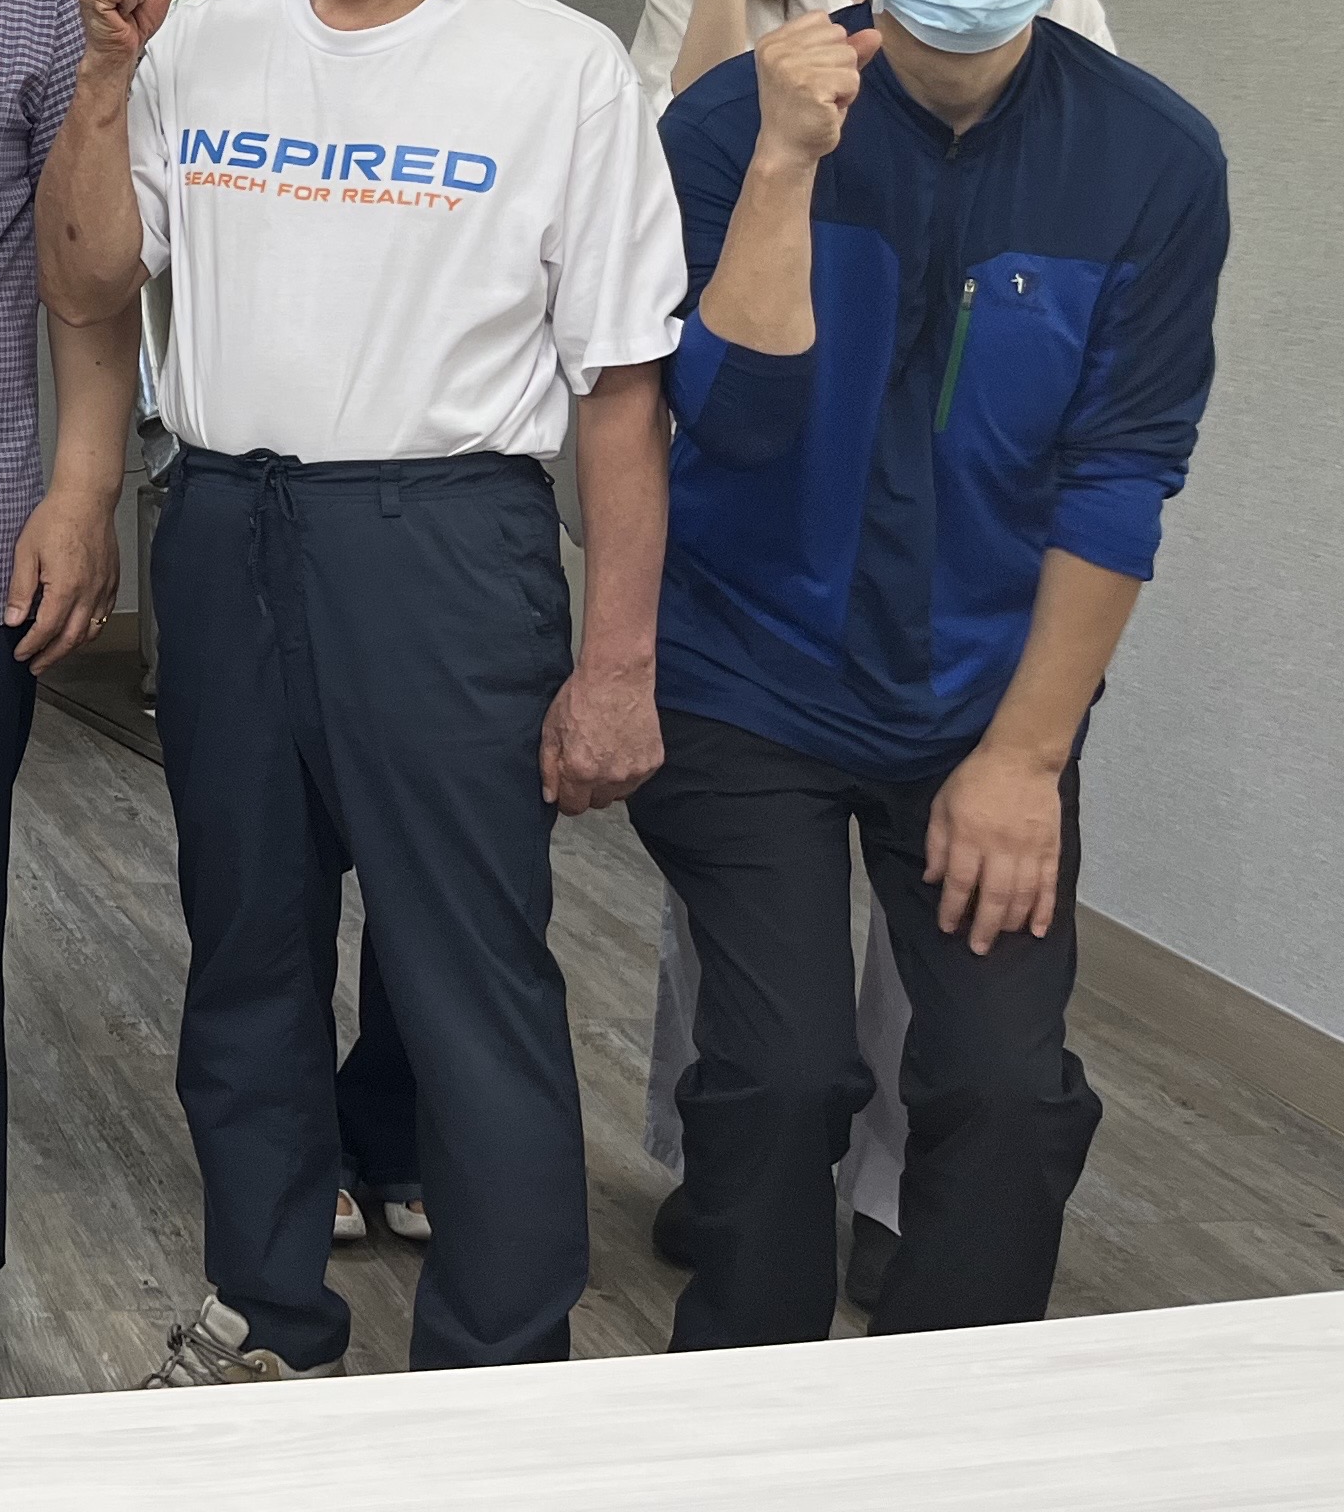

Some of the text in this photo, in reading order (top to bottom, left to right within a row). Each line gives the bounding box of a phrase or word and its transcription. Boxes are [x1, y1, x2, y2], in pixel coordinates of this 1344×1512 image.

[179, 128, 498, 193] INSPIRED
[184, 171, 464, 211] SEARCH FOR REALITY
